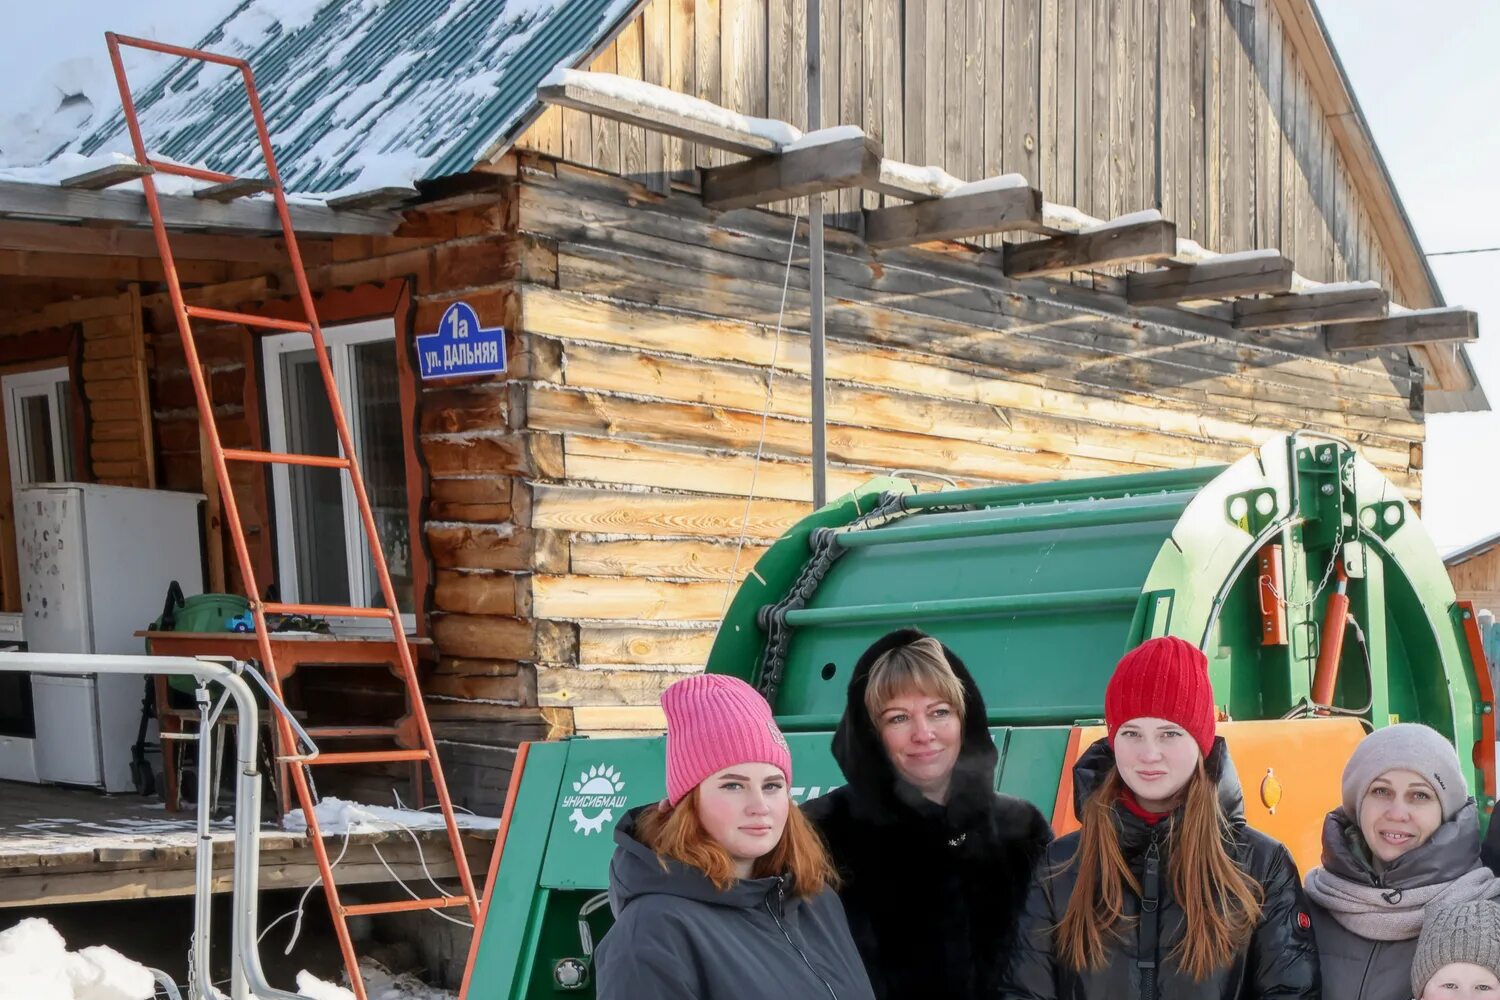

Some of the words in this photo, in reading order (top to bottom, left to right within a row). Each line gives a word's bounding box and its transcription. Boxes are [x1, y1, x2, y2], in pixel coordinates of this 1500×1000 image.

[448, 308, 468, 339] 1а
[425, 351, 442, 373] ул.
[443, 341, 498, 370] ДАЛЬНЯЯ
[562, 795, 627, 808] УНИСИБМАШ
